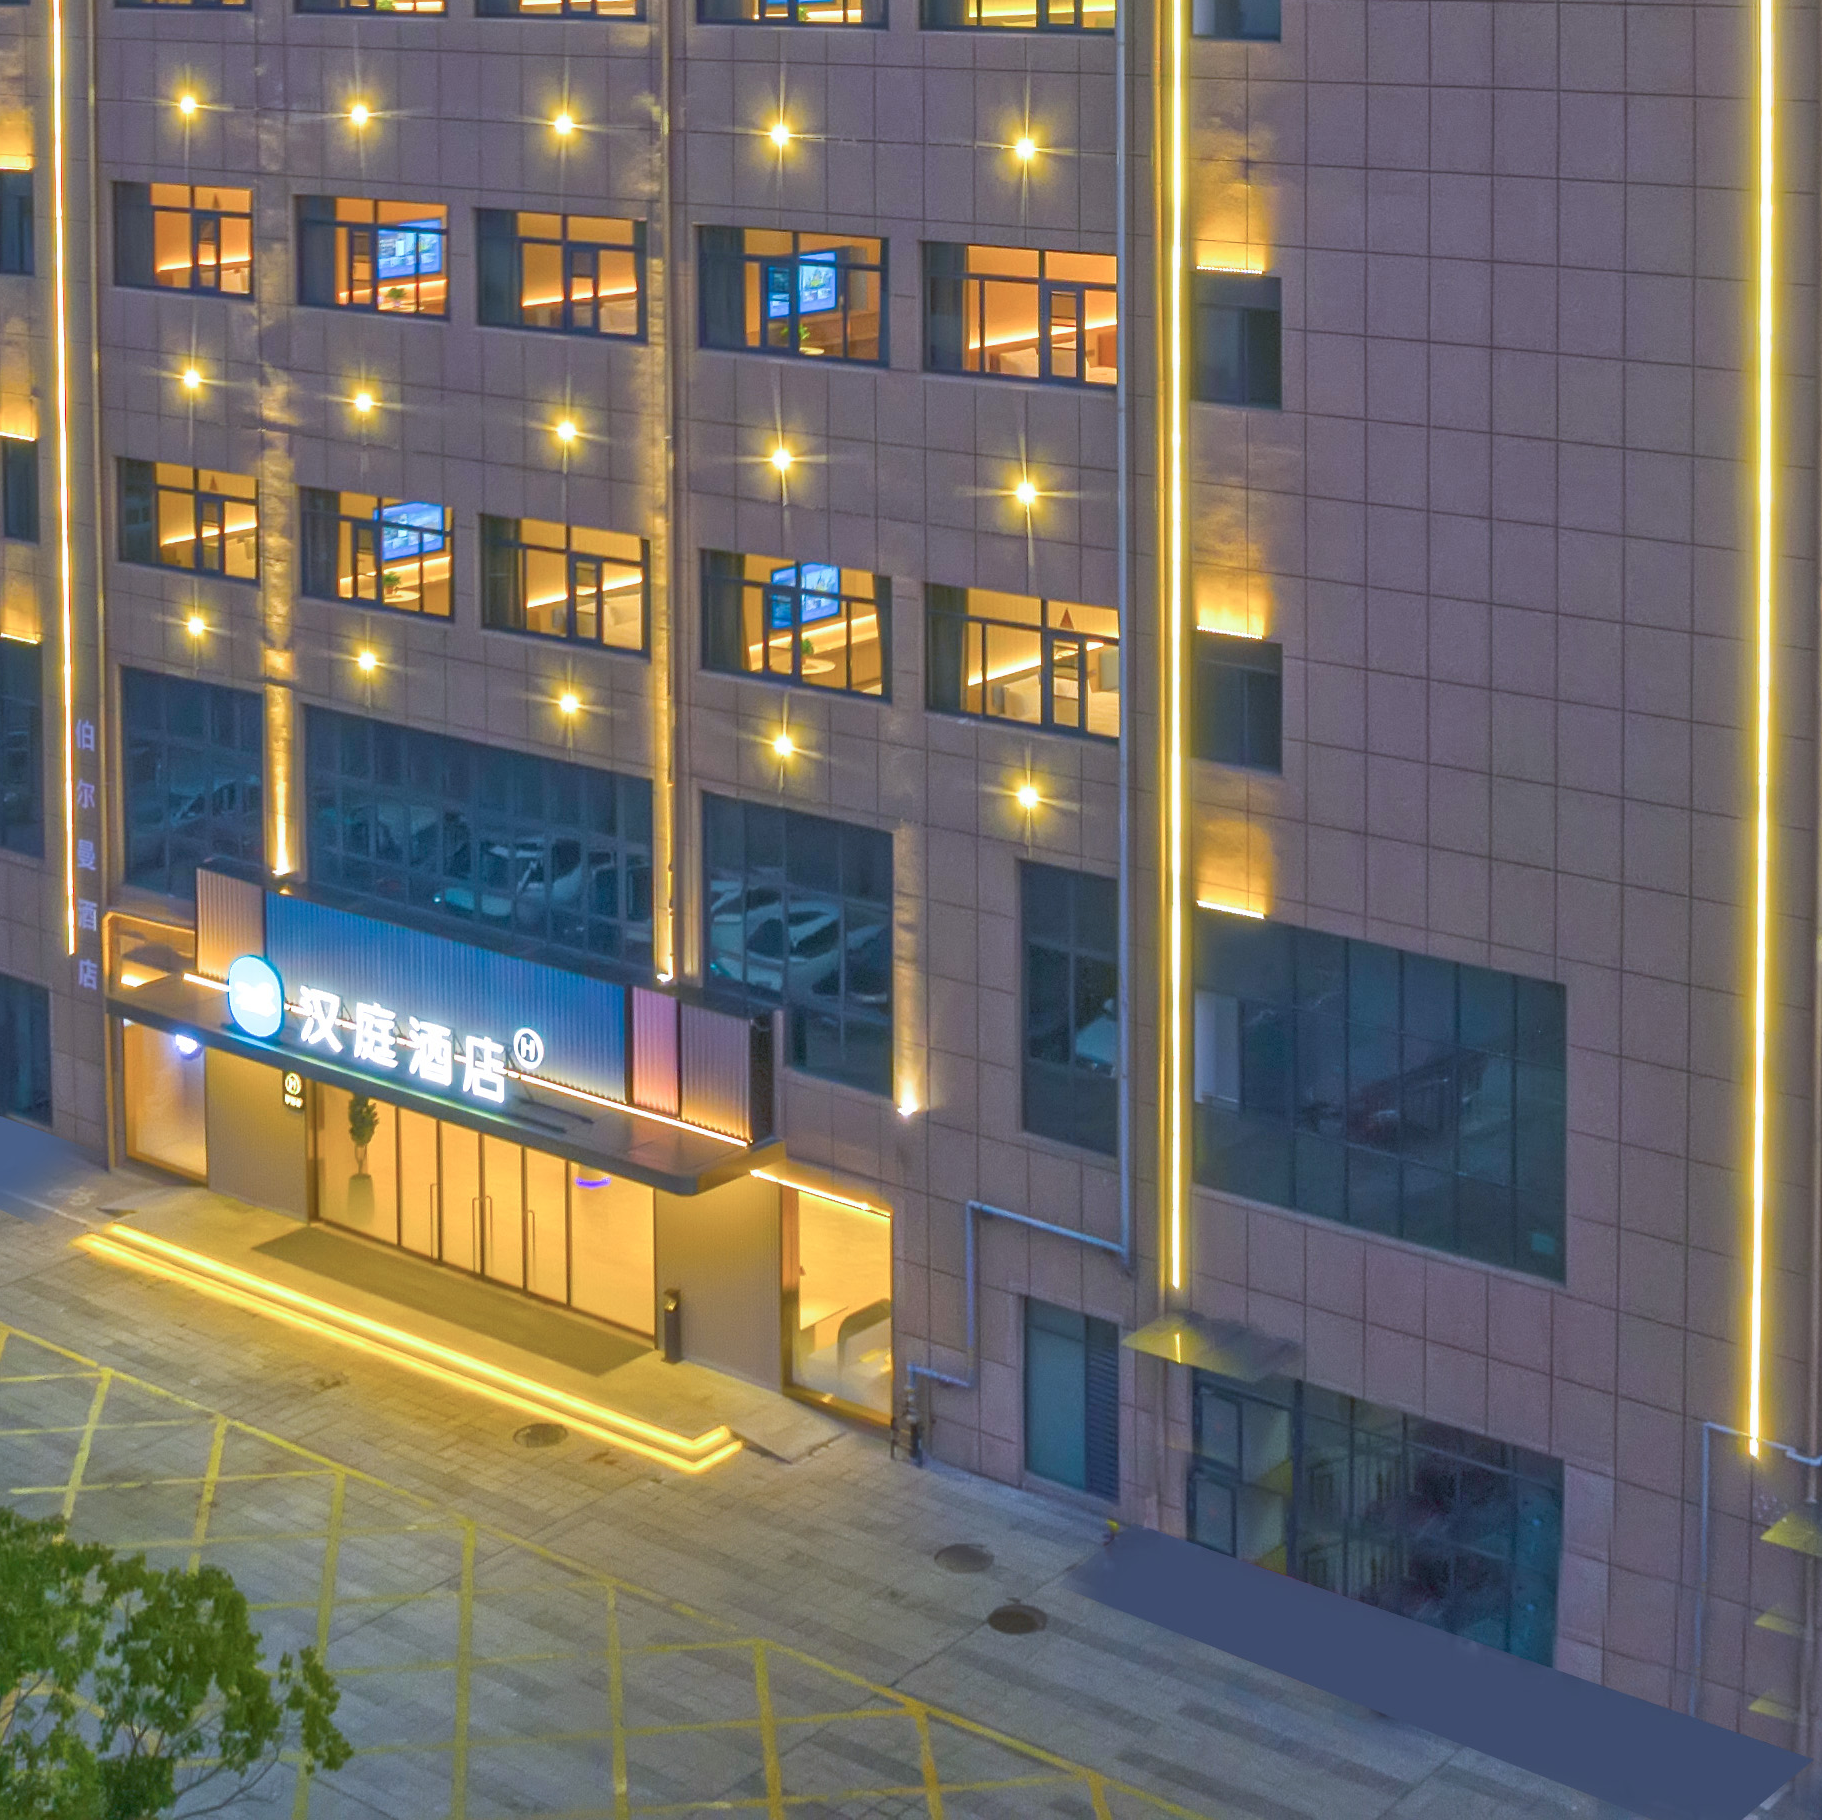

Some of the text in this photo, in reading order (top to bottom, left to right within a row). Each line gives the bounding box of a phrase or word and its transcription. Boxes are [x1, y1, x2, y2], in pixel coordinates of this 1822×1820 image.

[74, 718, 99, 992] 伯尔曼酒店
[298, 984, 506, 1104] 汉庭酒店
